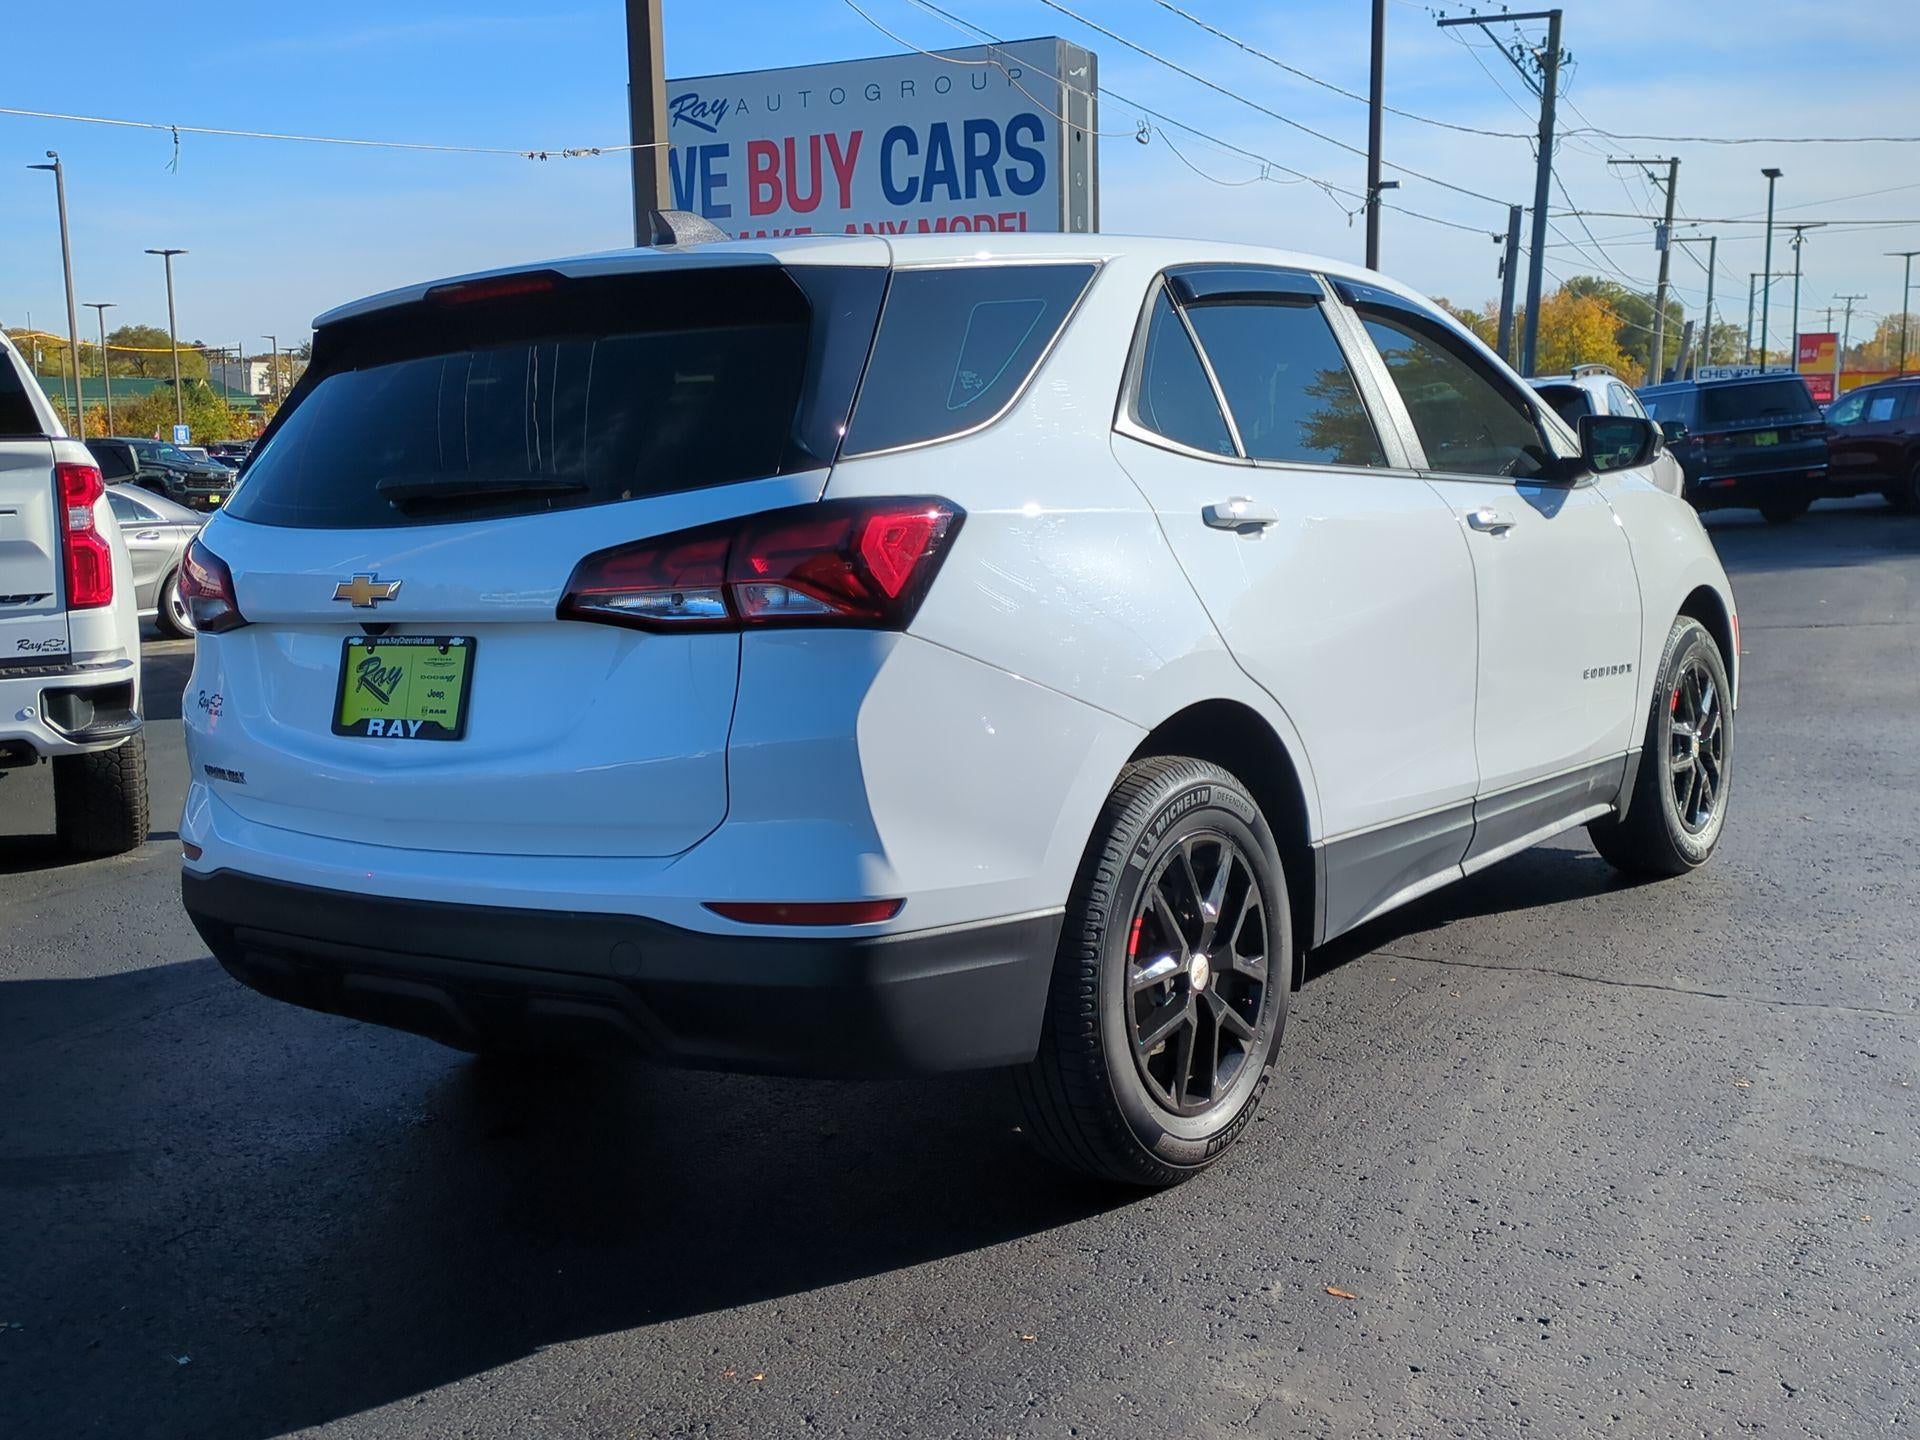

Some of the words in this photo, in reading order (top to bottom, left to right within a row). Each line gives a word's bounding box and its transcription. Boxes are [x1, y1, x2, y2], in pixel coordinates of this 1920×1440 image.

[669, 92, 729, 133] Ray
[735, 68, 1022, 115] AUTOGROUP
[747, 130, 863, 216] BUY
[880, 112, 1046, 206] CARS
[1699, 366, 1792, 379] CHEVROET
[17, 639, 42, 652] Ray
[356, 656, 402, 705] Ray
[367, 718, 423, 738] RAY
[1155, 788, 1210, 837] MICHELIN
